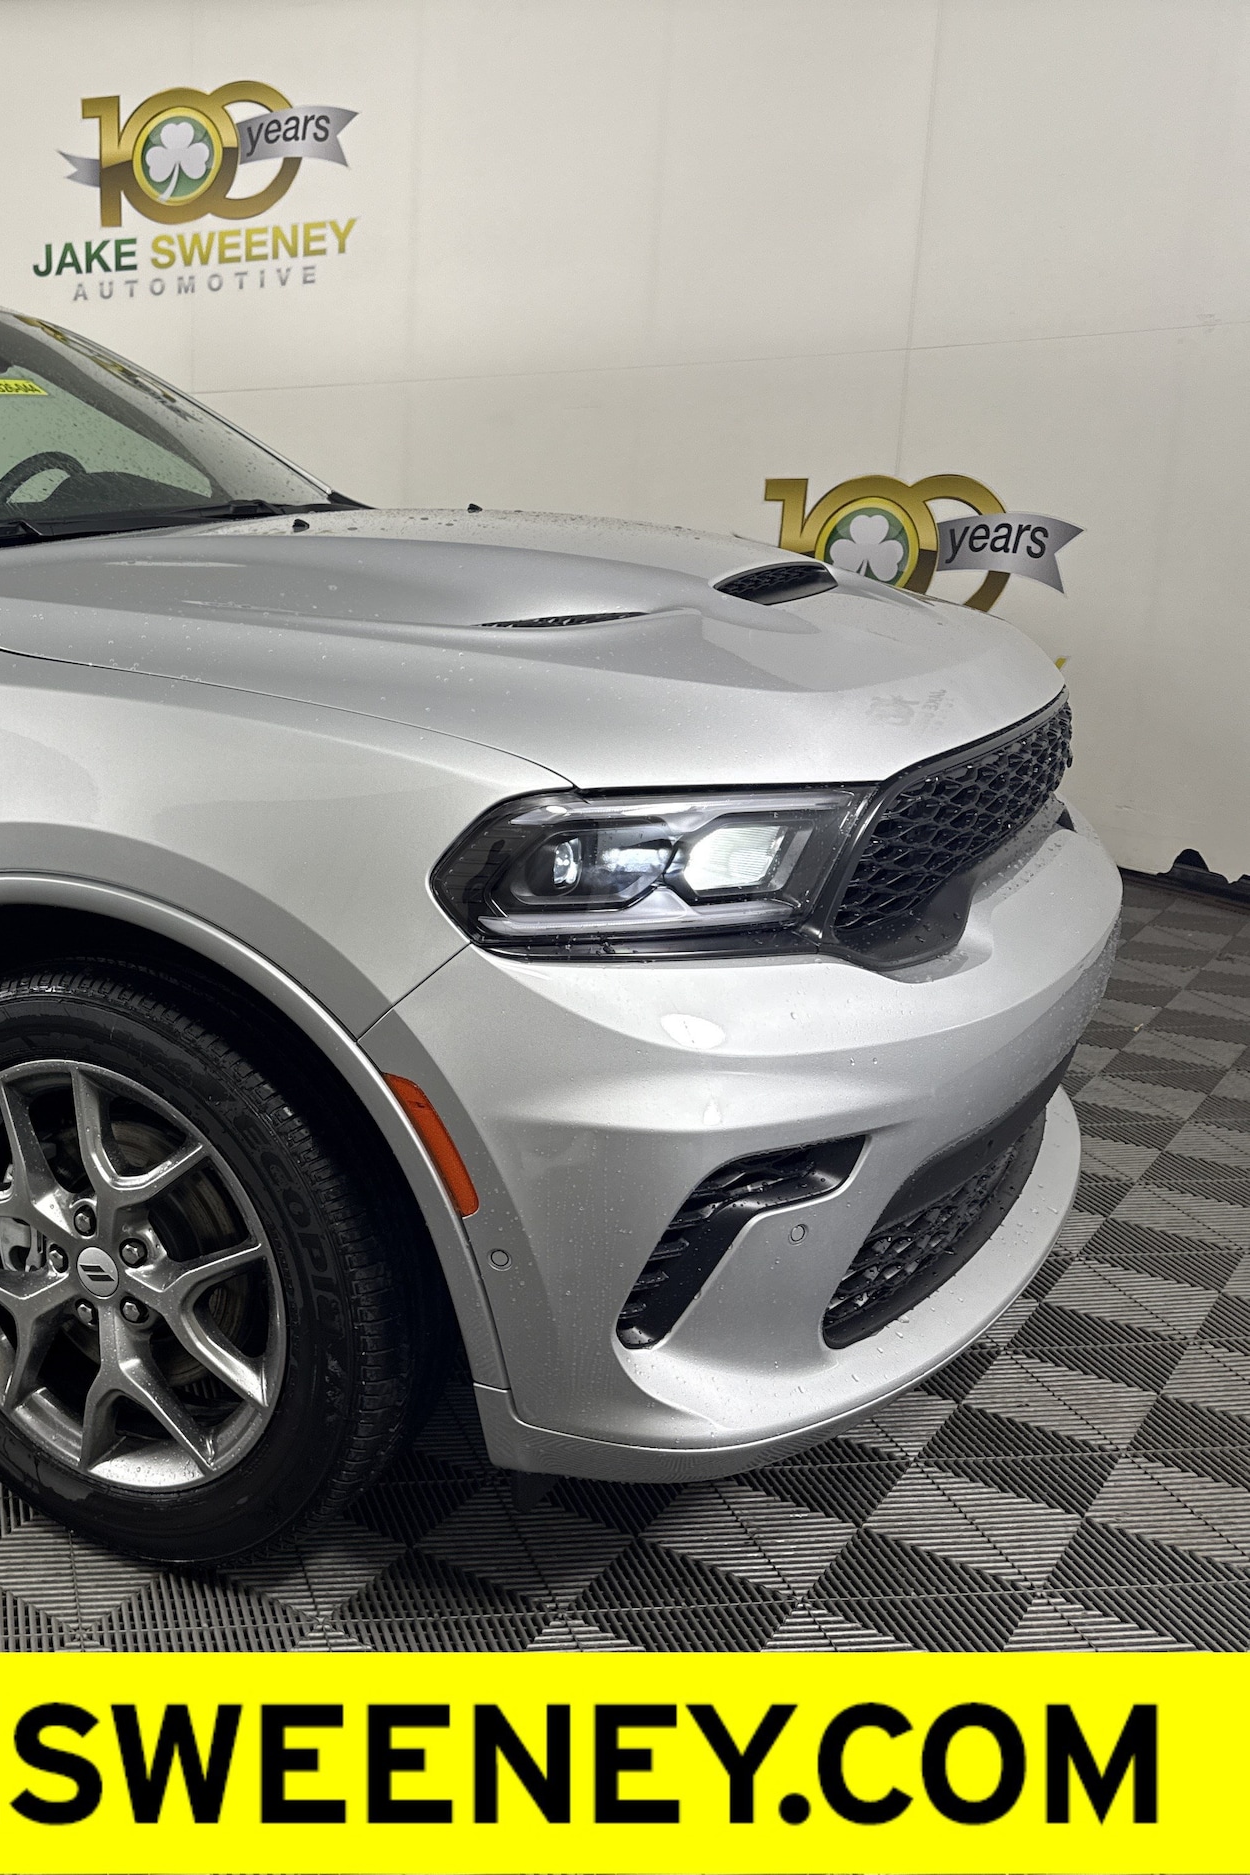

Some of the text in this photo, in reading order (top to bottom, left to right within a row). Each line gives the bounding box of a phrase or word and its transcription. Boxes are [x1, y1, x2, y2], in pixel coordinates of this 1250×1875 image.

[81, 80, 330, 228] 100 years
[33, 218, 357, 278] JAKE SWEENEY
[72, 265, 317, 302] AUTOMOTIVE
[945, 522, 1049, 564] years
